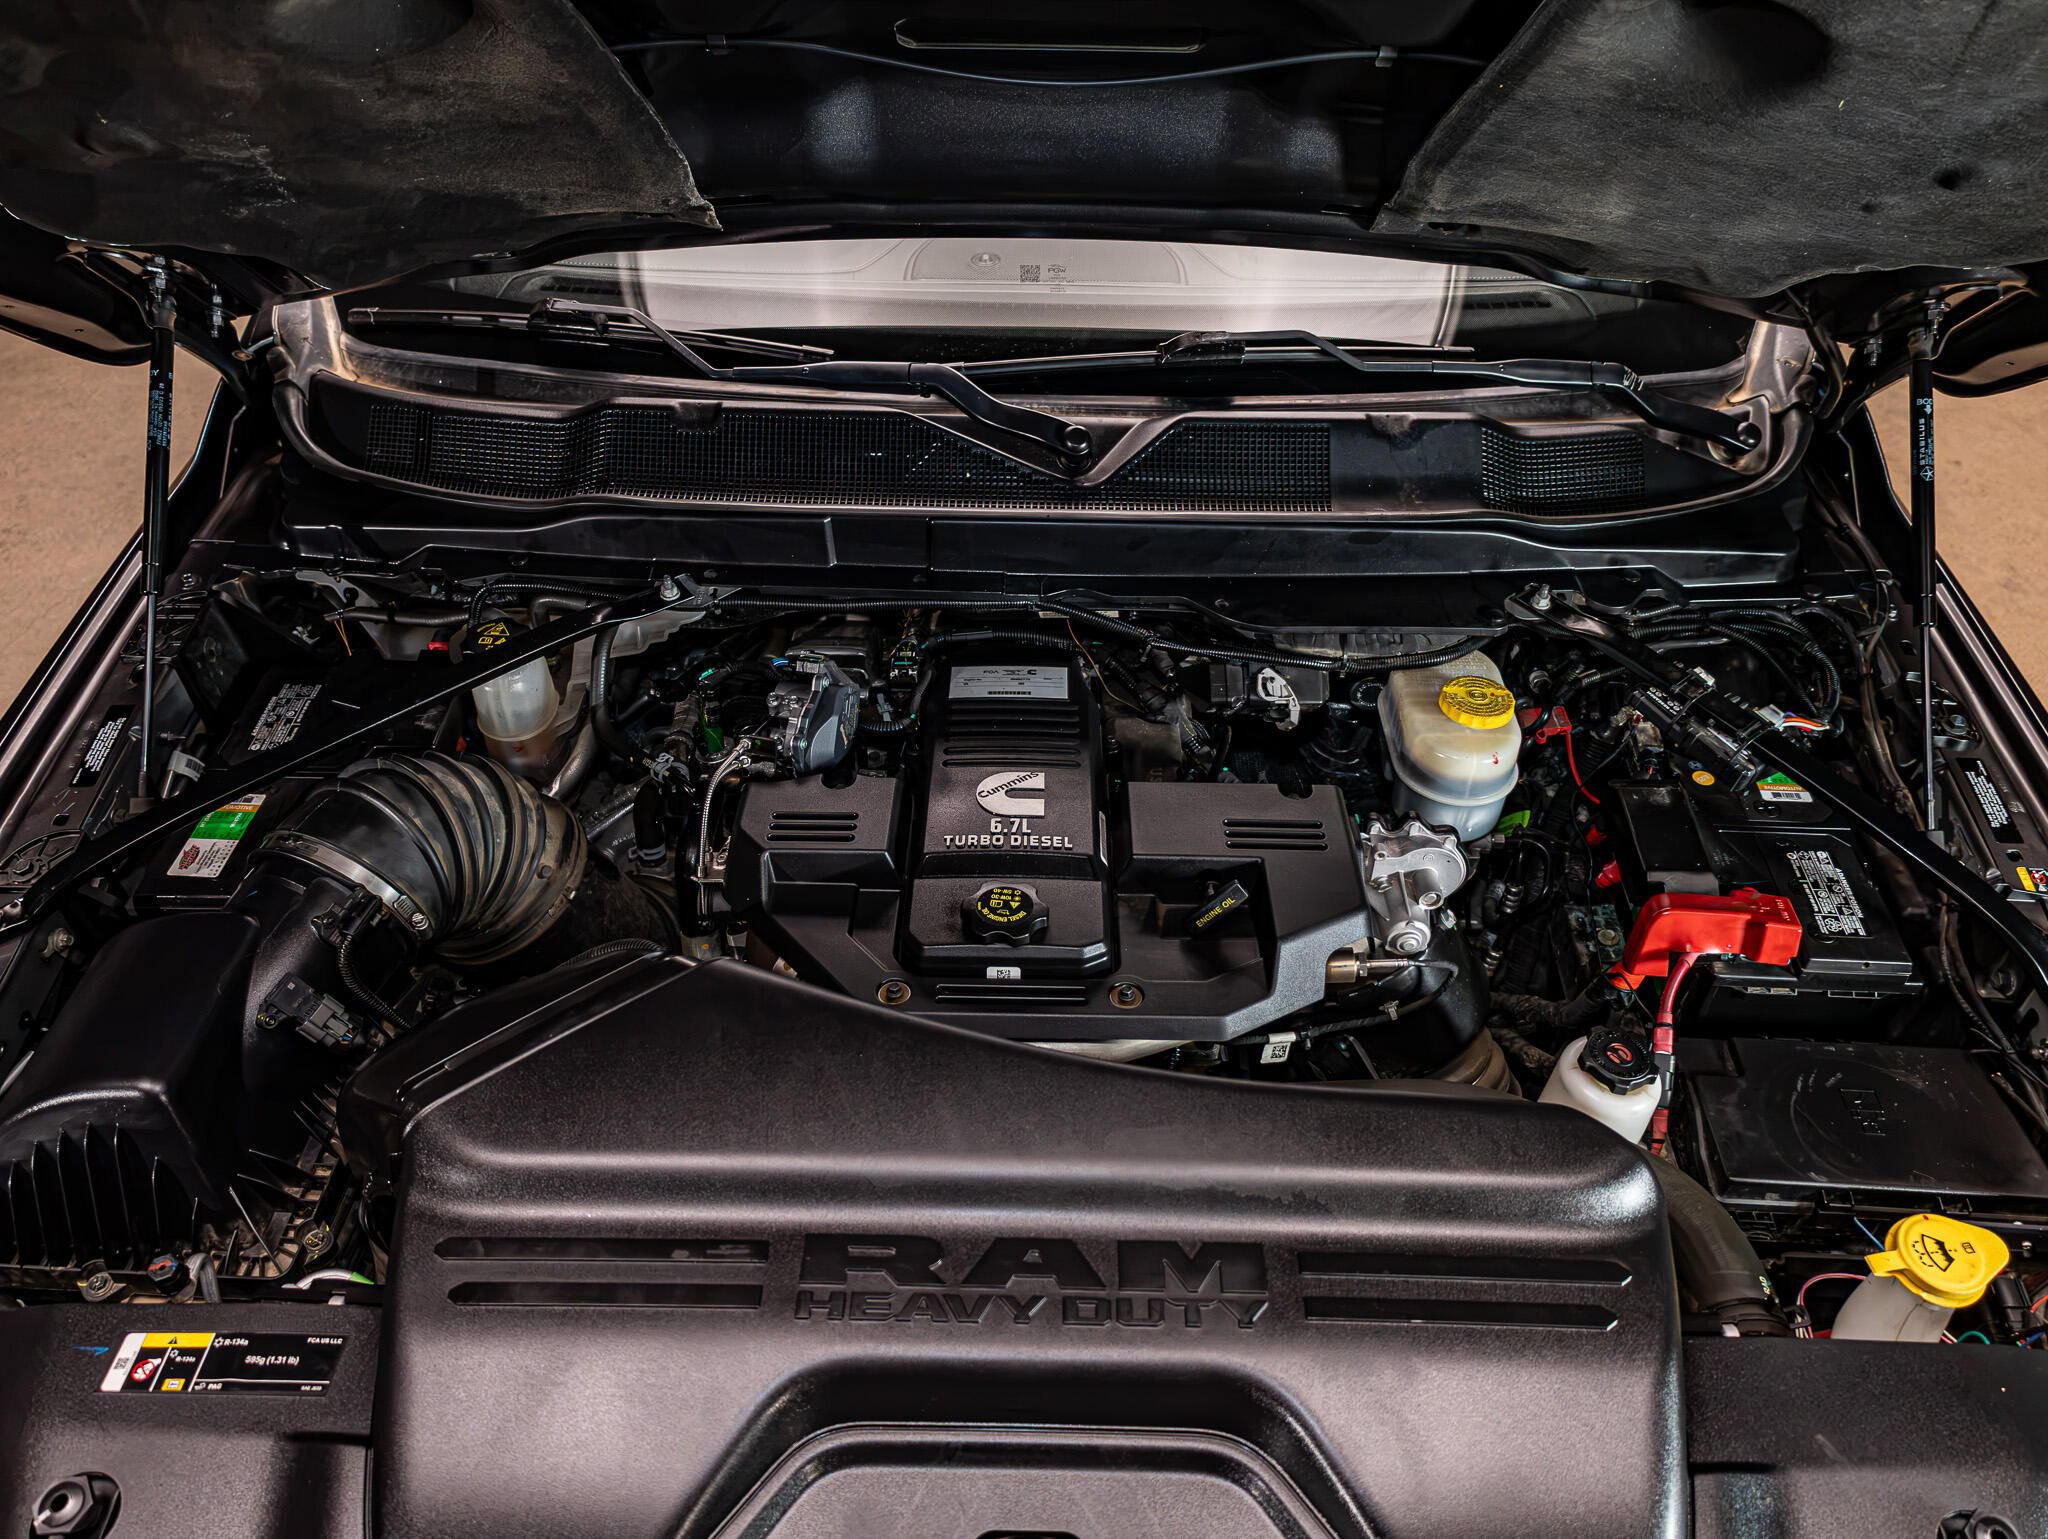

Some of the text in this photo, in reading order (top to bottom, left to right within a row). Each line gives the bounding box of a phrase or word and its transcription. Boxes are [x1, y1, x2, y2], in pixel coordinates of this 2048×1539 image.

[977, 771, 1039, 799] Cummins
[990, 818, 1032, 833] 6.7L
[943, 834, 1073, 849] TURBO DIESEL
[1195, 897, 1236, 928] ENGINE OIL
[799, 1233, 1269, 1296] RAM
[794, 1290, 1270, 1329] HEAVY DUTY
[223, 1338, 249, 1347] R-134a
